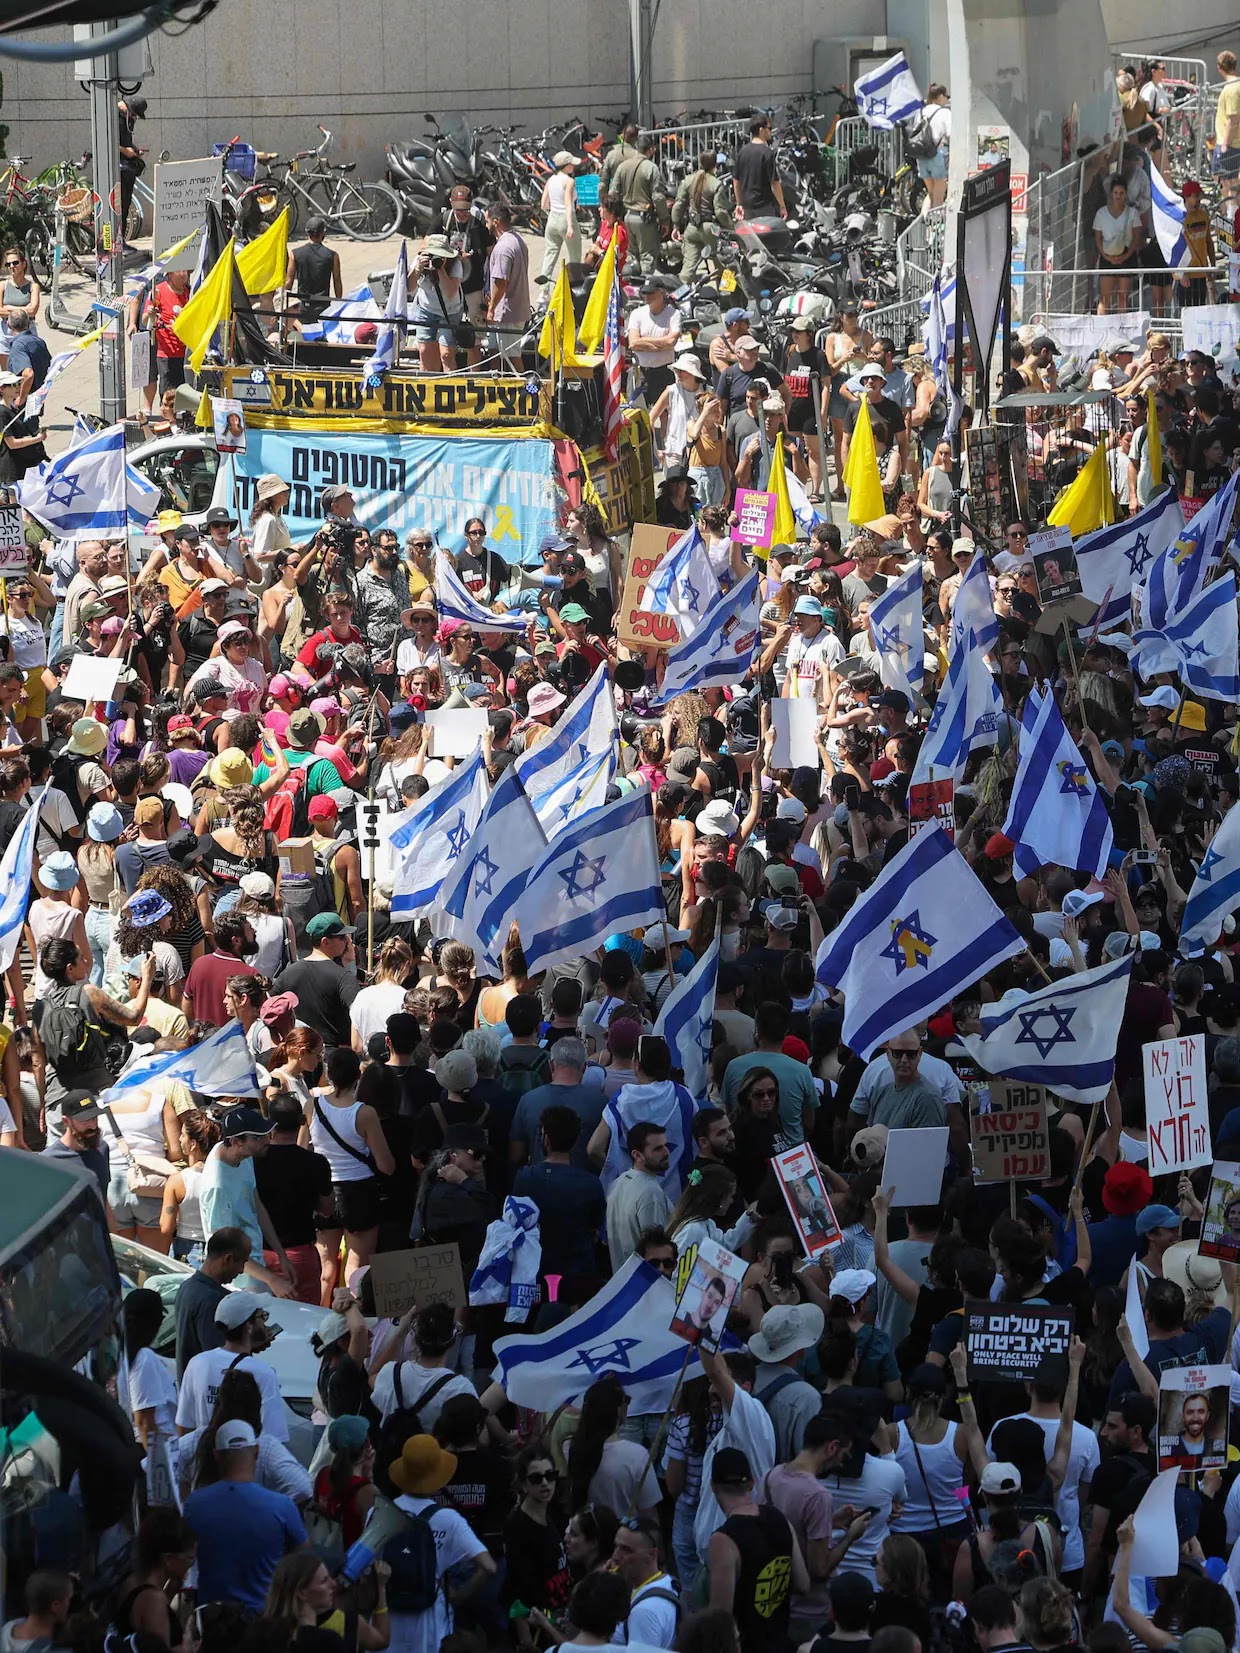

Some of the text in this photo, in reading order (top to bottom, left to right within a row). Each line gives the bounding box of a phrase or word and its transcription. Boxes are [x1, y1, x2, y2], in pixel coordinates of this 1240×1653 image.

[274, 377, 540, 416] מצילים את ישראל
[292, 447, 406, 492] החטופים
[742, 525, 763, 534] חיים
[1152, 1043, 1169, 1077] לא
[1005, 1085, 1041, 1112] מגן
[1163, 1070, 1196, 1117] בוץ
[974, 1111, 1040, 1134] כיסאו
[980, 1130, 1046, 1153] מפקיר
[1149, 1112, 1192, 1168] חרא
[1204, 1222, 1224, 1235] BRING
[989, 1314, 1070, 1337] רק שלום
[968, 1333, 1068, 1354] יביא ביטחון
[973, 1350, 1042, 1361] ONLY PEACE WILL
[973, 1357, 1040, 1368] BRING SECURITY
[1160, 1436, 1180, 1446] BRING
[1160, 1446, 1172, 1456] HIM
